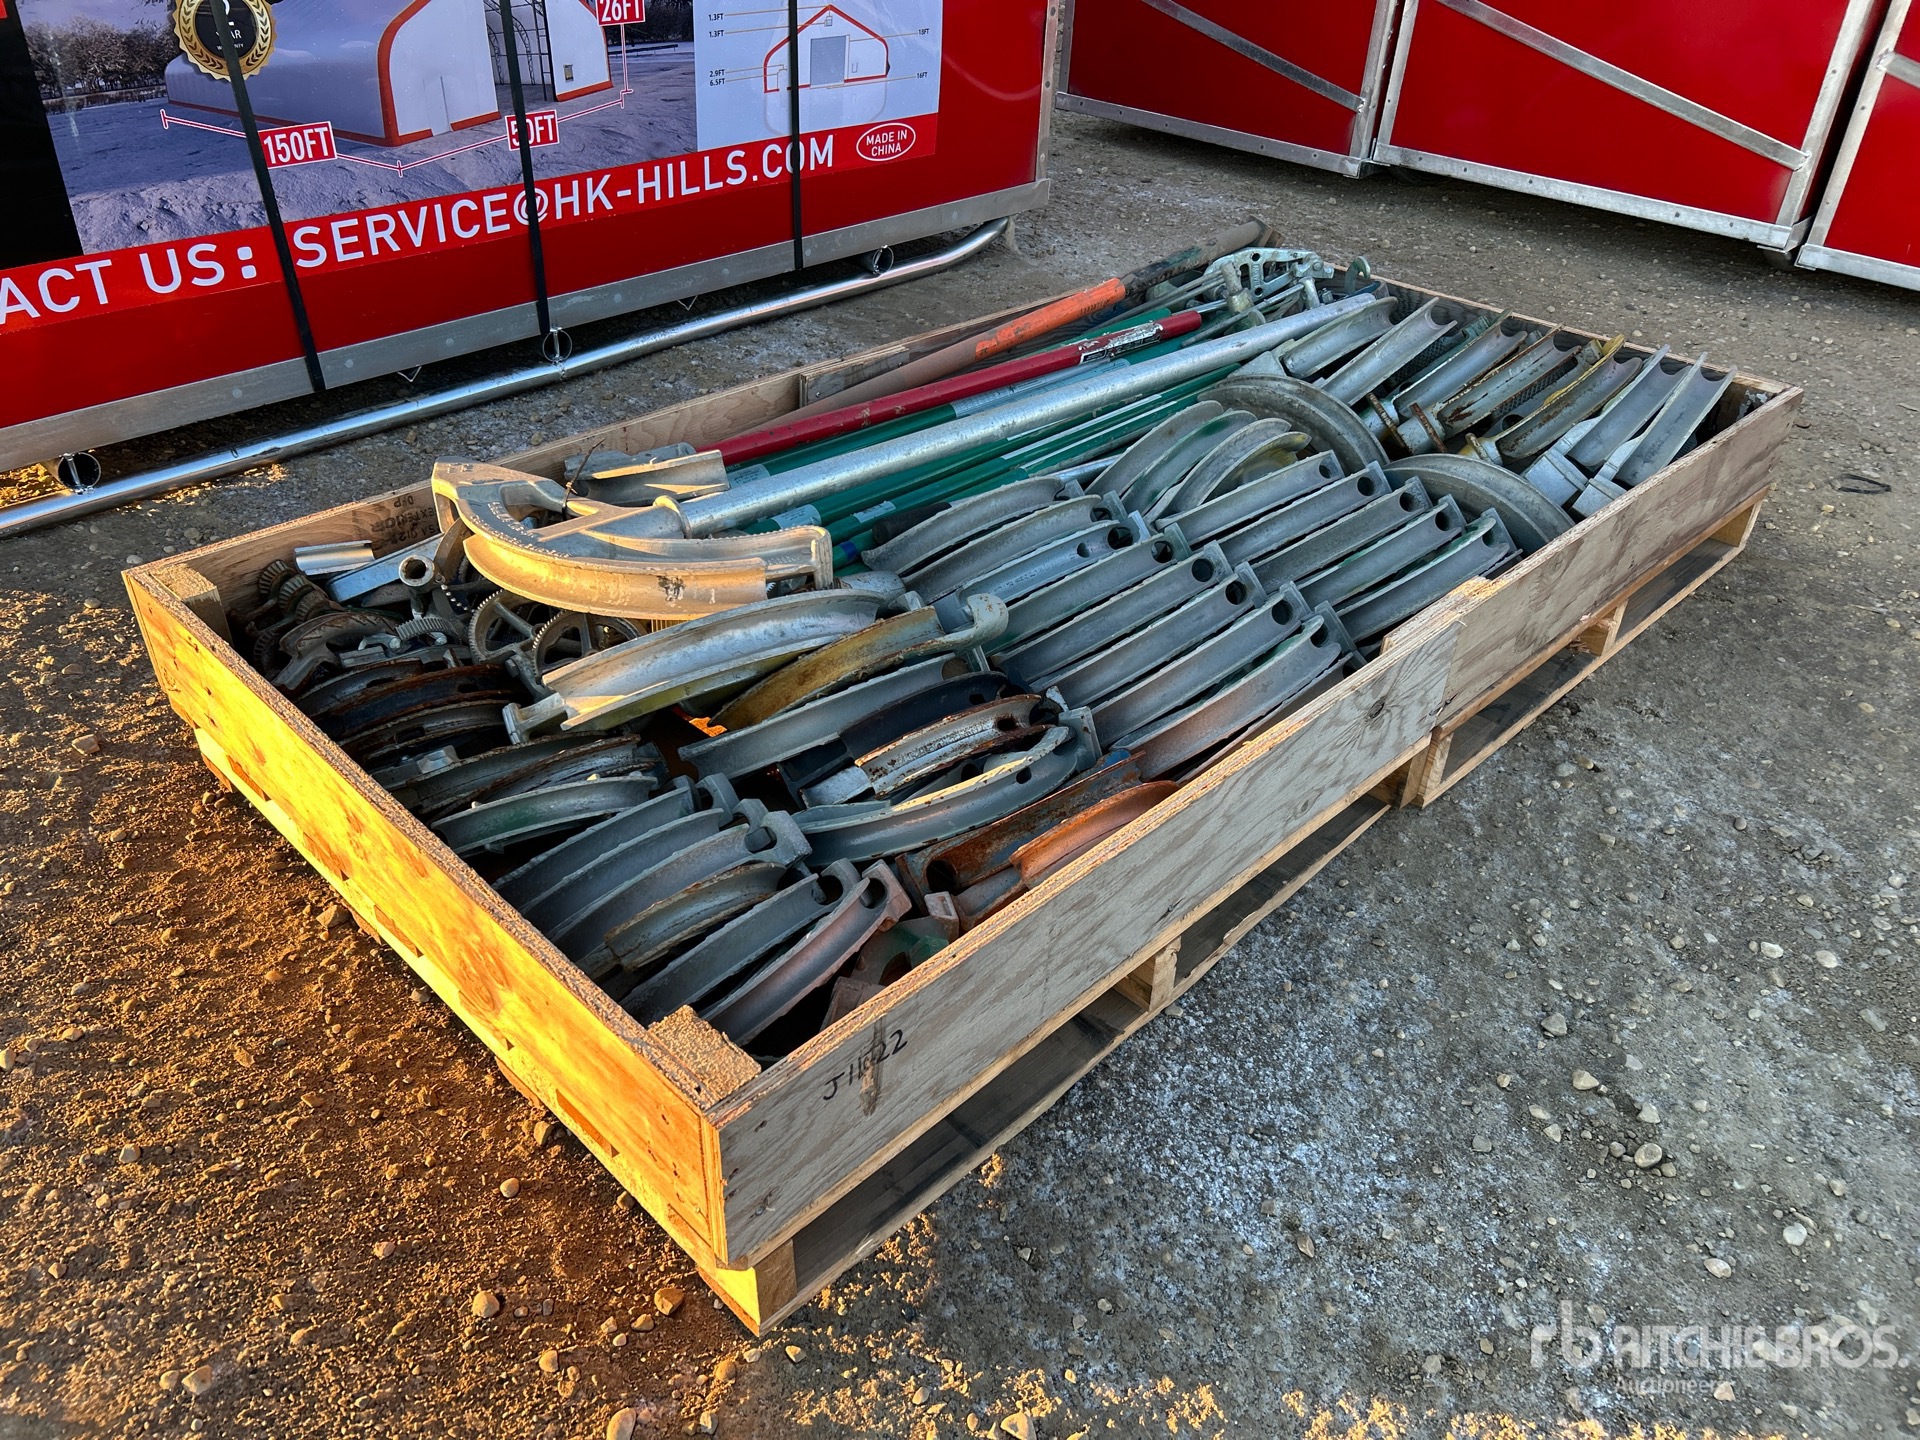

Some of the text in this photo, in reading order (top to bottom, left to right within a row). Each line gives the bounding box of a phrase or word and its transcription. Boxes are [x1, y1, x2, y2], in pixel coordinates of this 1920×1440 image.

[708, 13, 724, 21] 1.3FT
[709, 30, 724, 38] 1.3FT
[709, 69, 725, 77] 2.9FT
[709, 78, 725, 87] 6.5FT
[866, 129, 908, 146] MADE IN
[263, 126, 329, 164] 150FT
[871, 142, 902, 157] CHINA
[139, 243, 257, 295] US:
[293, 134, 833, 268] SERVICE@HK-HILLS.COM
